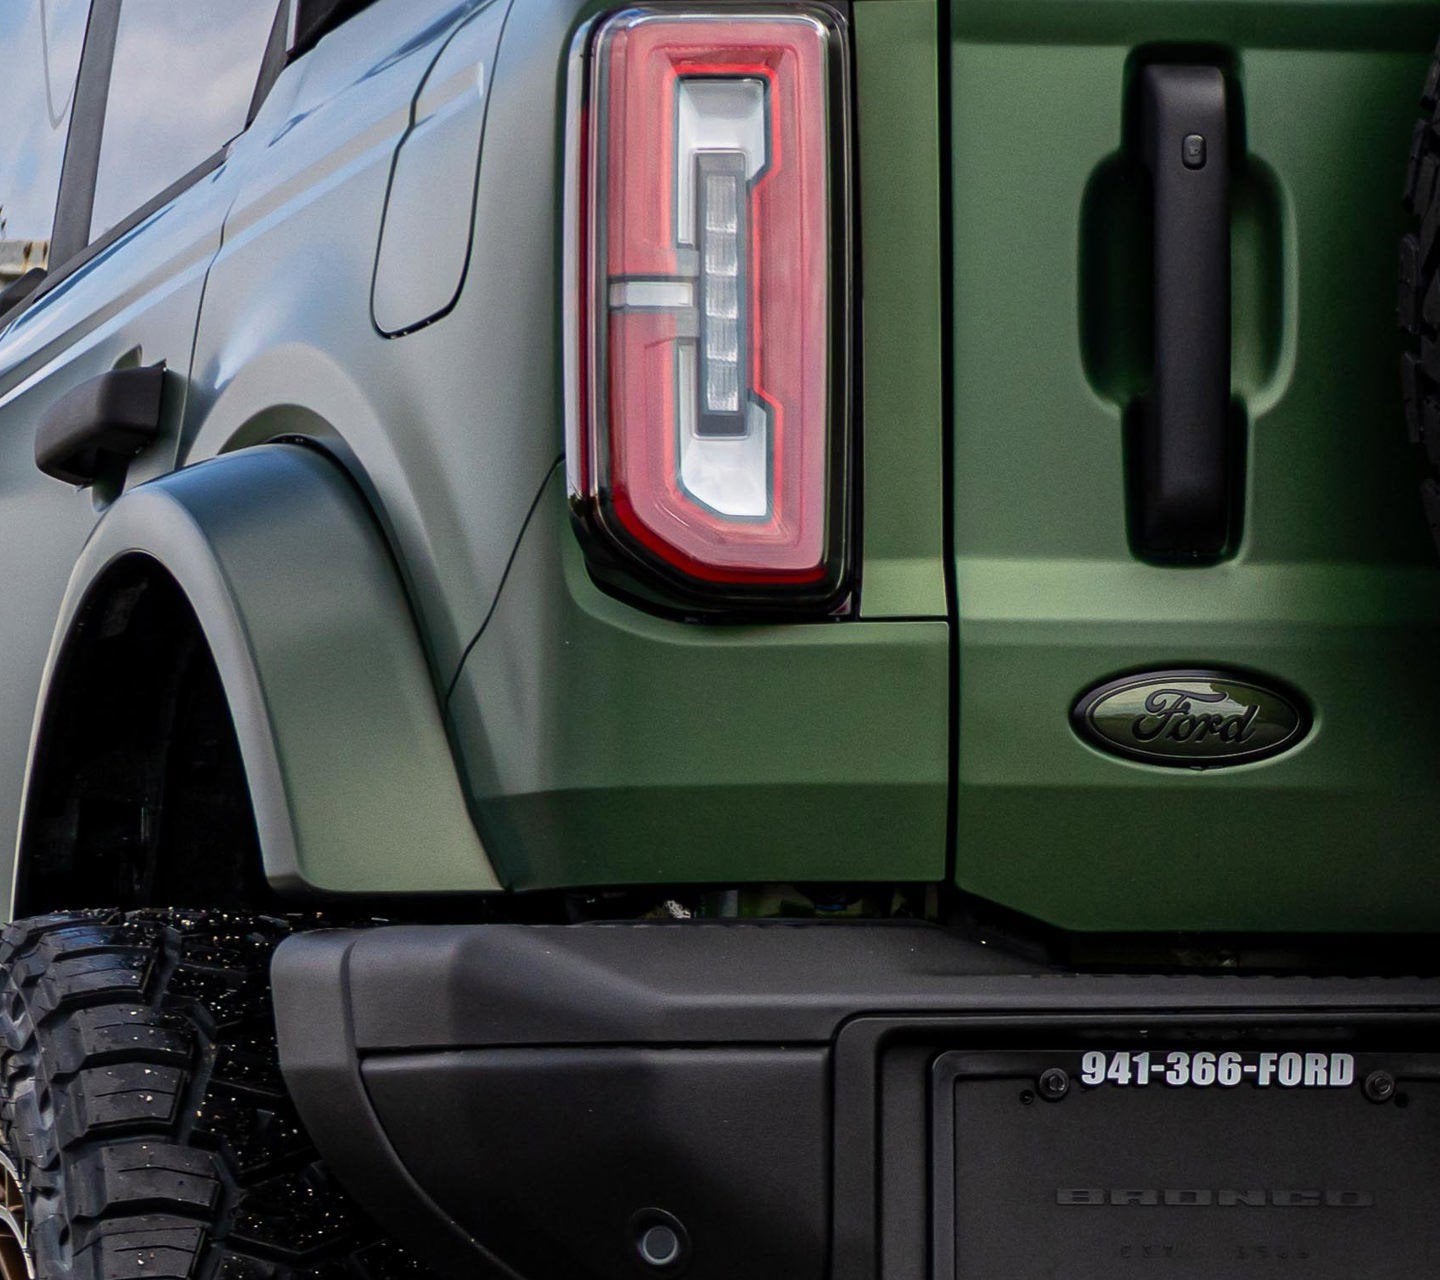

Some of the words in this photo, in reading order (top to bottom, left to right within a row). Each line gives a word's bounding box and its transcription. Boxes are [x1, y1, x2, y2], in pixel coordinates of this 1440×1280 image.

[1132, 689, 1260, 743] Ford
[1081, 1051, 1355, 1086] 941-366-FORD
[1057, 1187, 1375, 1206] BRONCO
